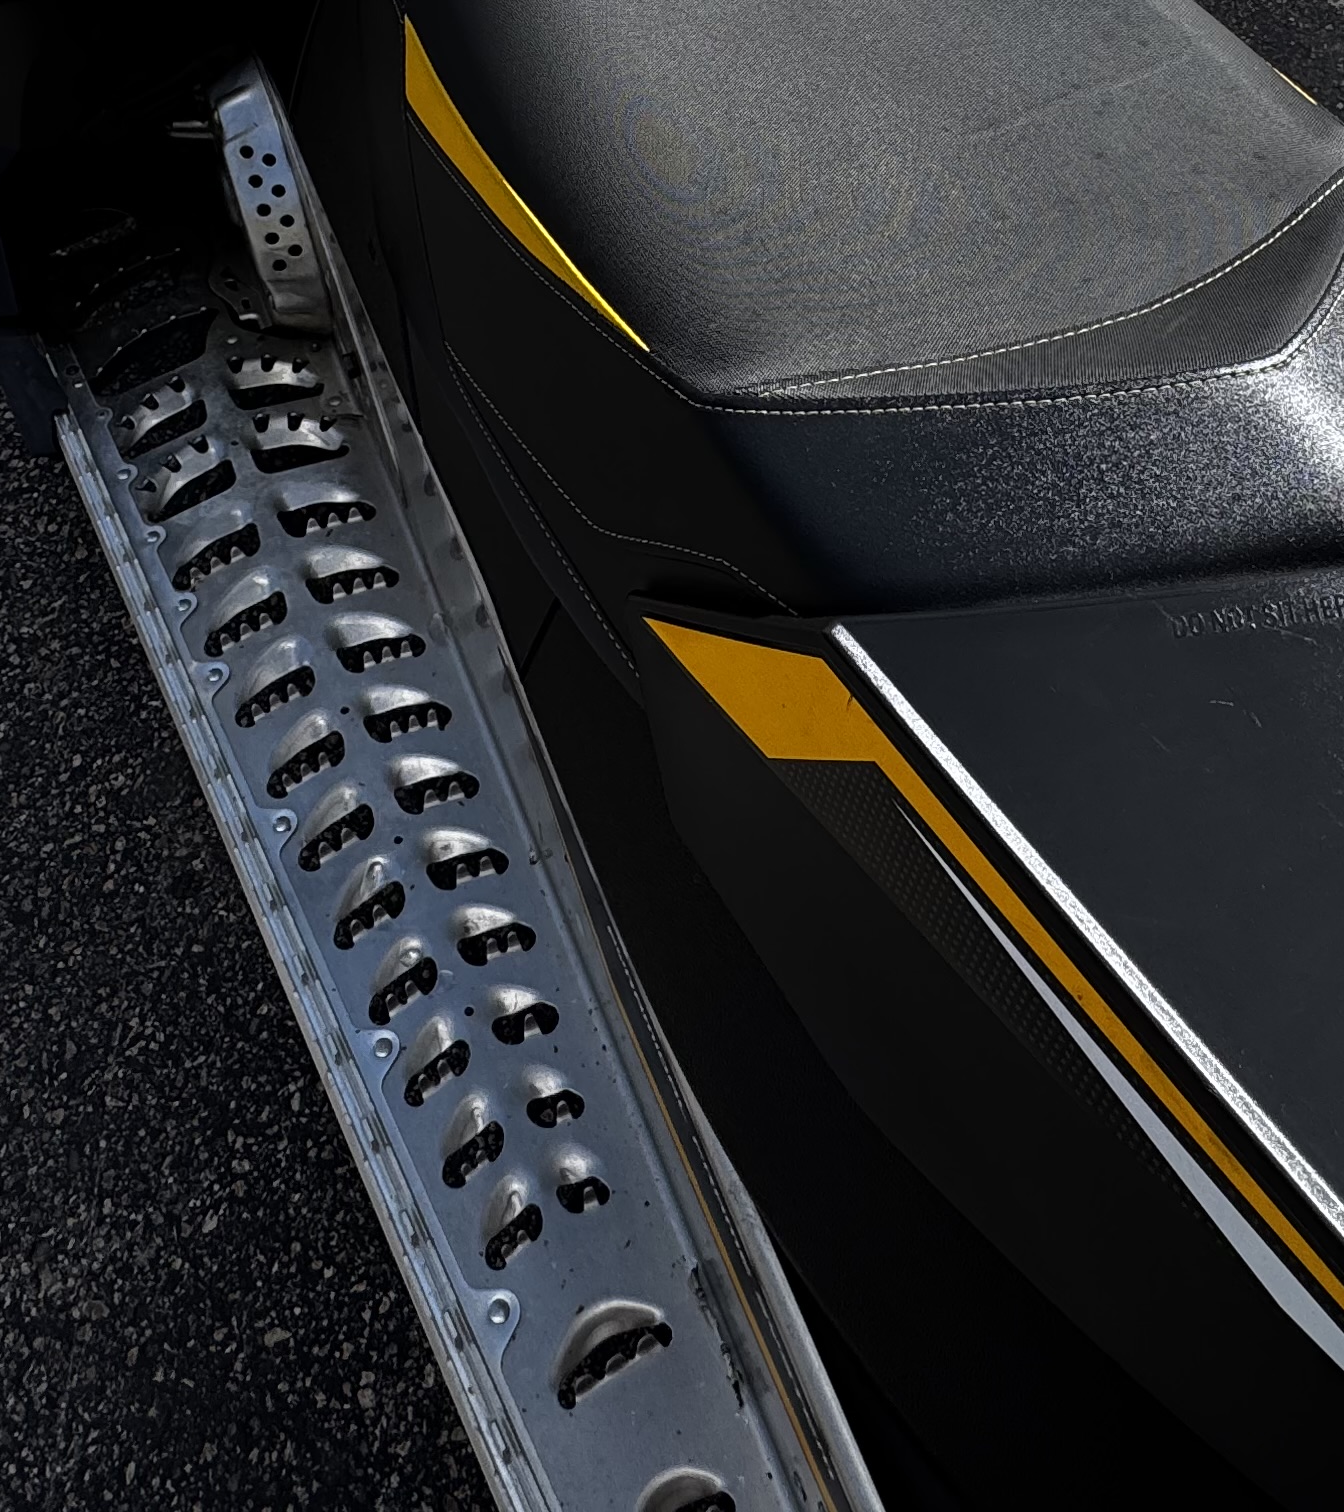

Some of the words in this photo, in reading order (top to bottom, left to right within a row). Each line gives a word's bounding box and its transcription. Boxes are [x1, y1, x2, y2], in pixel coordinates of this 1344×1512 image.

[1171, 612, 1205, 639] DO
[1211, 604, 1256, 634] NOT
[1262, 599, 1298, 628] SIT
